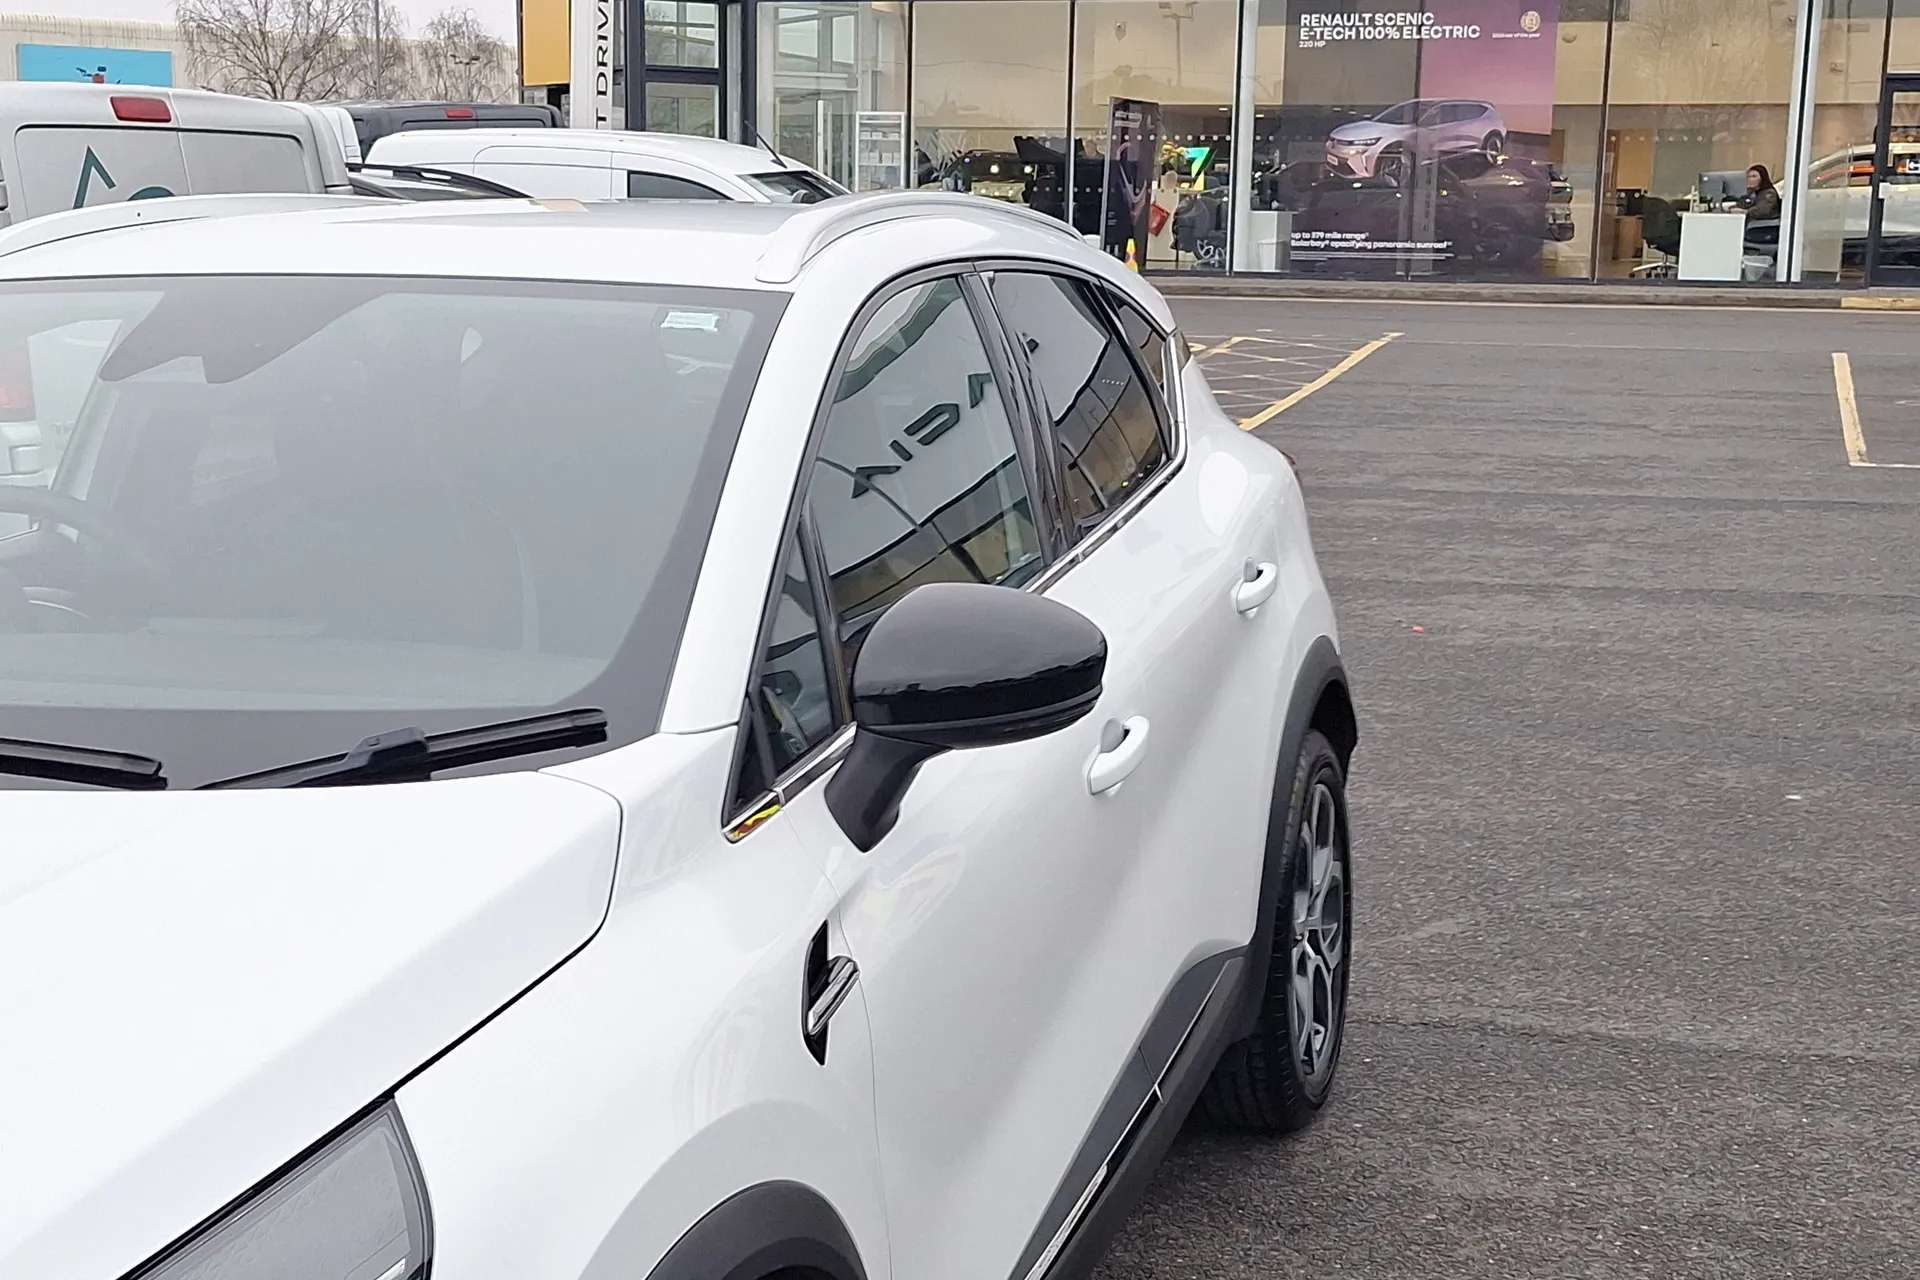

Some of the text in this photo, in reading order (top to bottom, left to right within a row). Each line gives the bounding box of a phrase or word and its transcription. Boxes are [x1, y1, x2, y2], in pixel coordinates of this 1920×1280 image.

[1300, 12, 1435, 26] RENAULT SCENIC
[1300, 27, 1356, 40] E-TECH
[1358, 26, 1400, 40] 100%
[1403, 25, 1480, 39] ELECTRIC
[596, 0, 609, 97] DRIV
